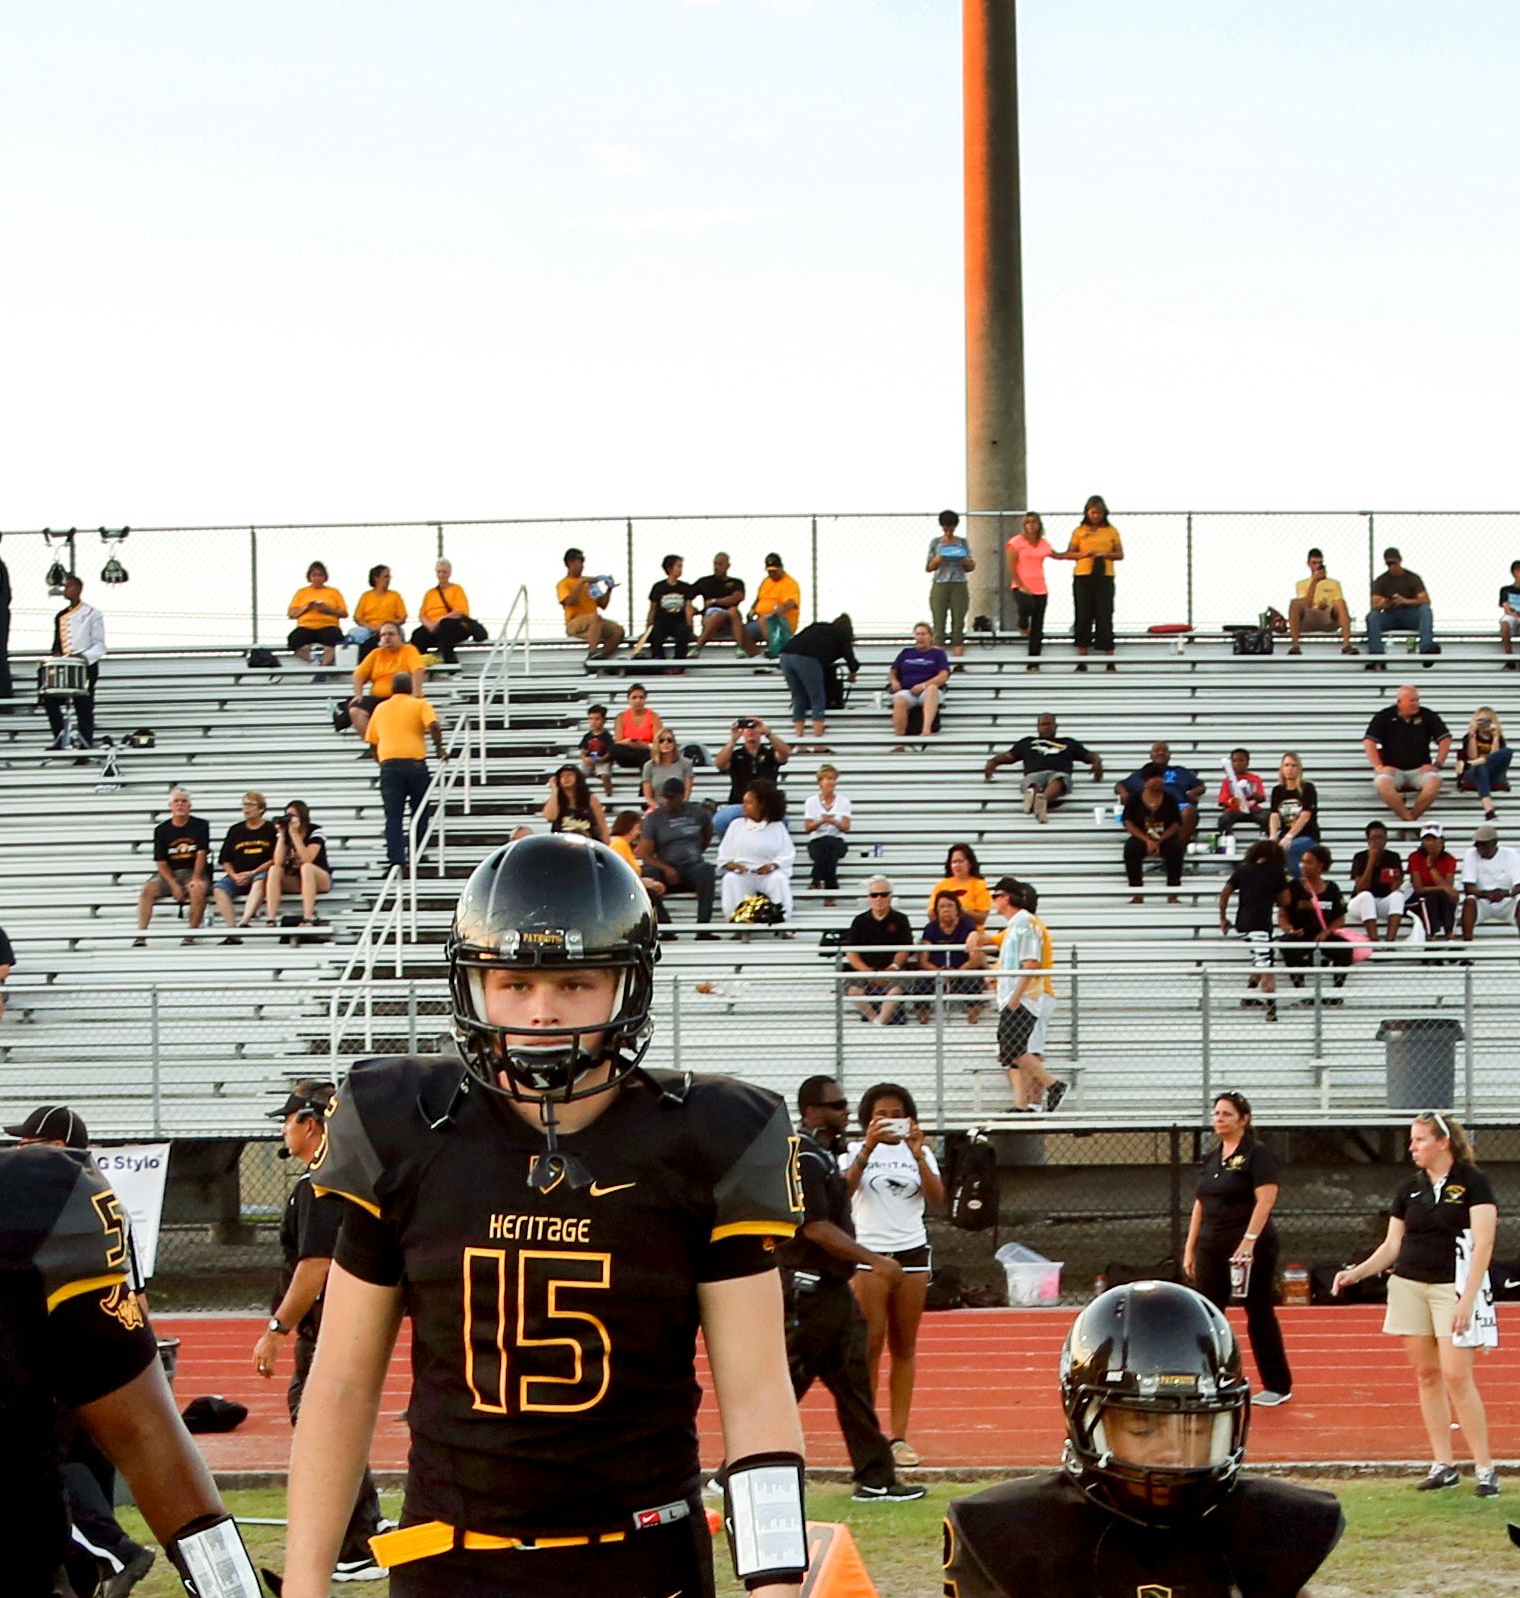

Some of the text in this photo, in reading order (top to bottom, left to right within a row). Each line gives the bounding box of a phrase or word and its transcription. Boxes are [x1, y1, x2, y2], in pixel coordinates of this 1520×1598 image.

[97, 1156, 160, 1172] G Stylo
[489, 1213, 592, 1243] HERITAGE
[462, 1247, 612, 1414] 15
